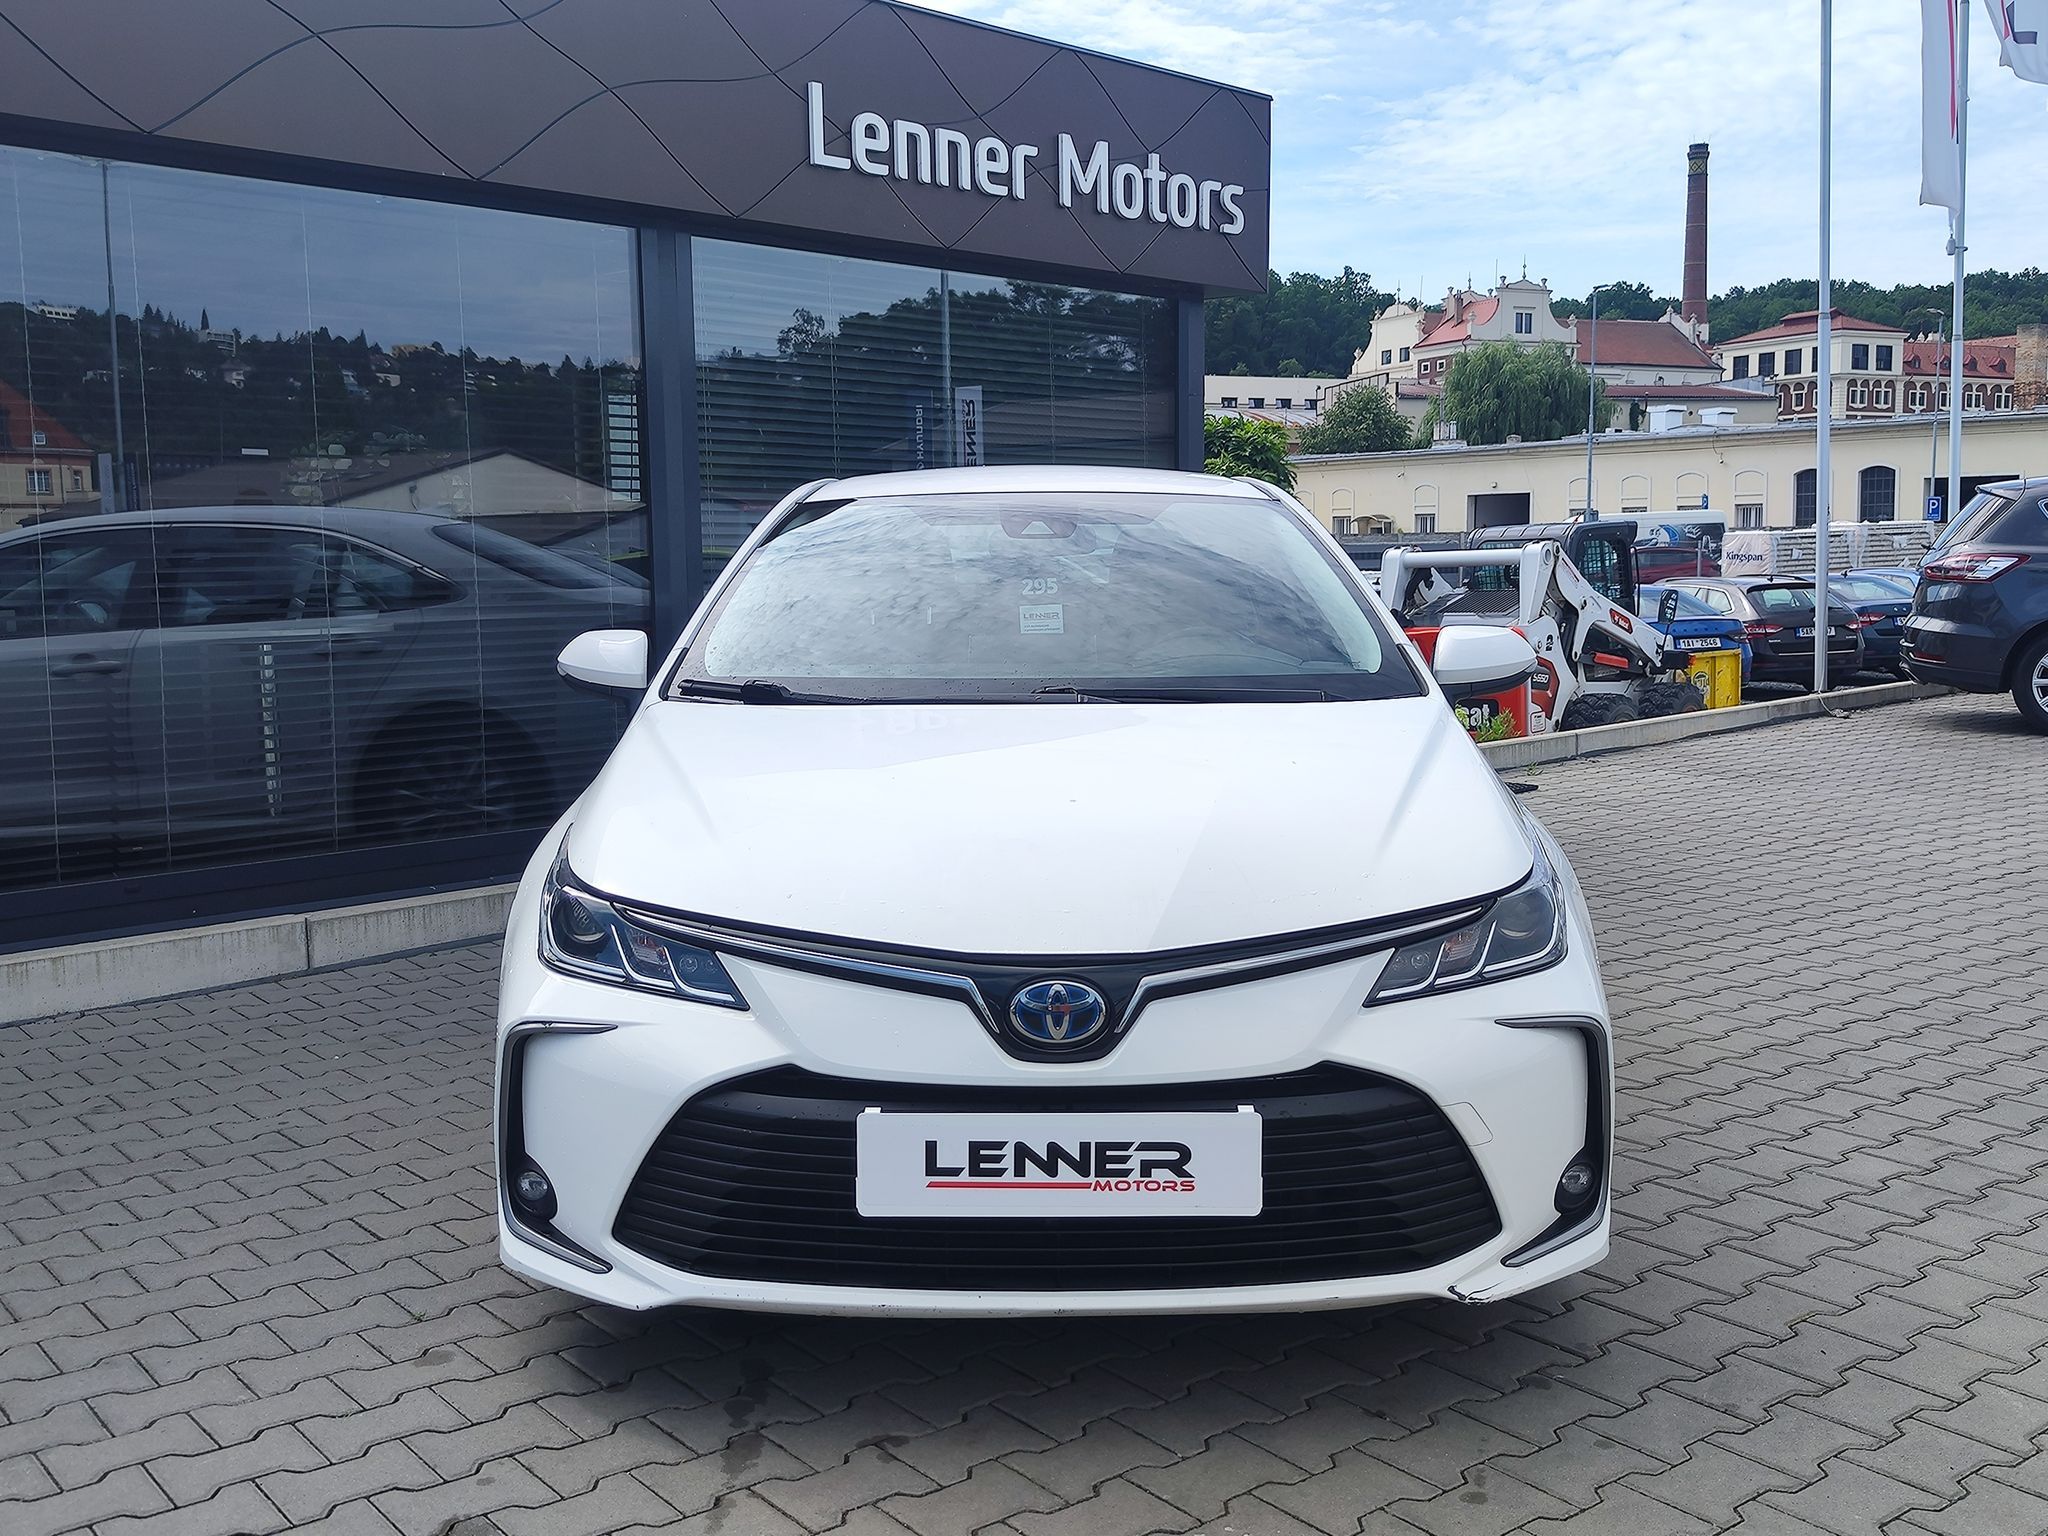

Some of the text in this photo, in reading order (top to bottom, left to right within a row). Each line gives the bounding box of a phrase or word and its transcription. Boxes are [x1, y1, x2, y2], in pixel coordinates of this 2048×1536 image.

[807, 81, 1245, 235] Lenner Motors
[1929, 499, 1938, 514] P
[1725, 551, 1763, 562] Kingspan
[1022, 577, 1058, 595] 295
[924, 1140, 1194, 1178] LENNER
[1092, 1180, 1196, 1192] MOTORS
